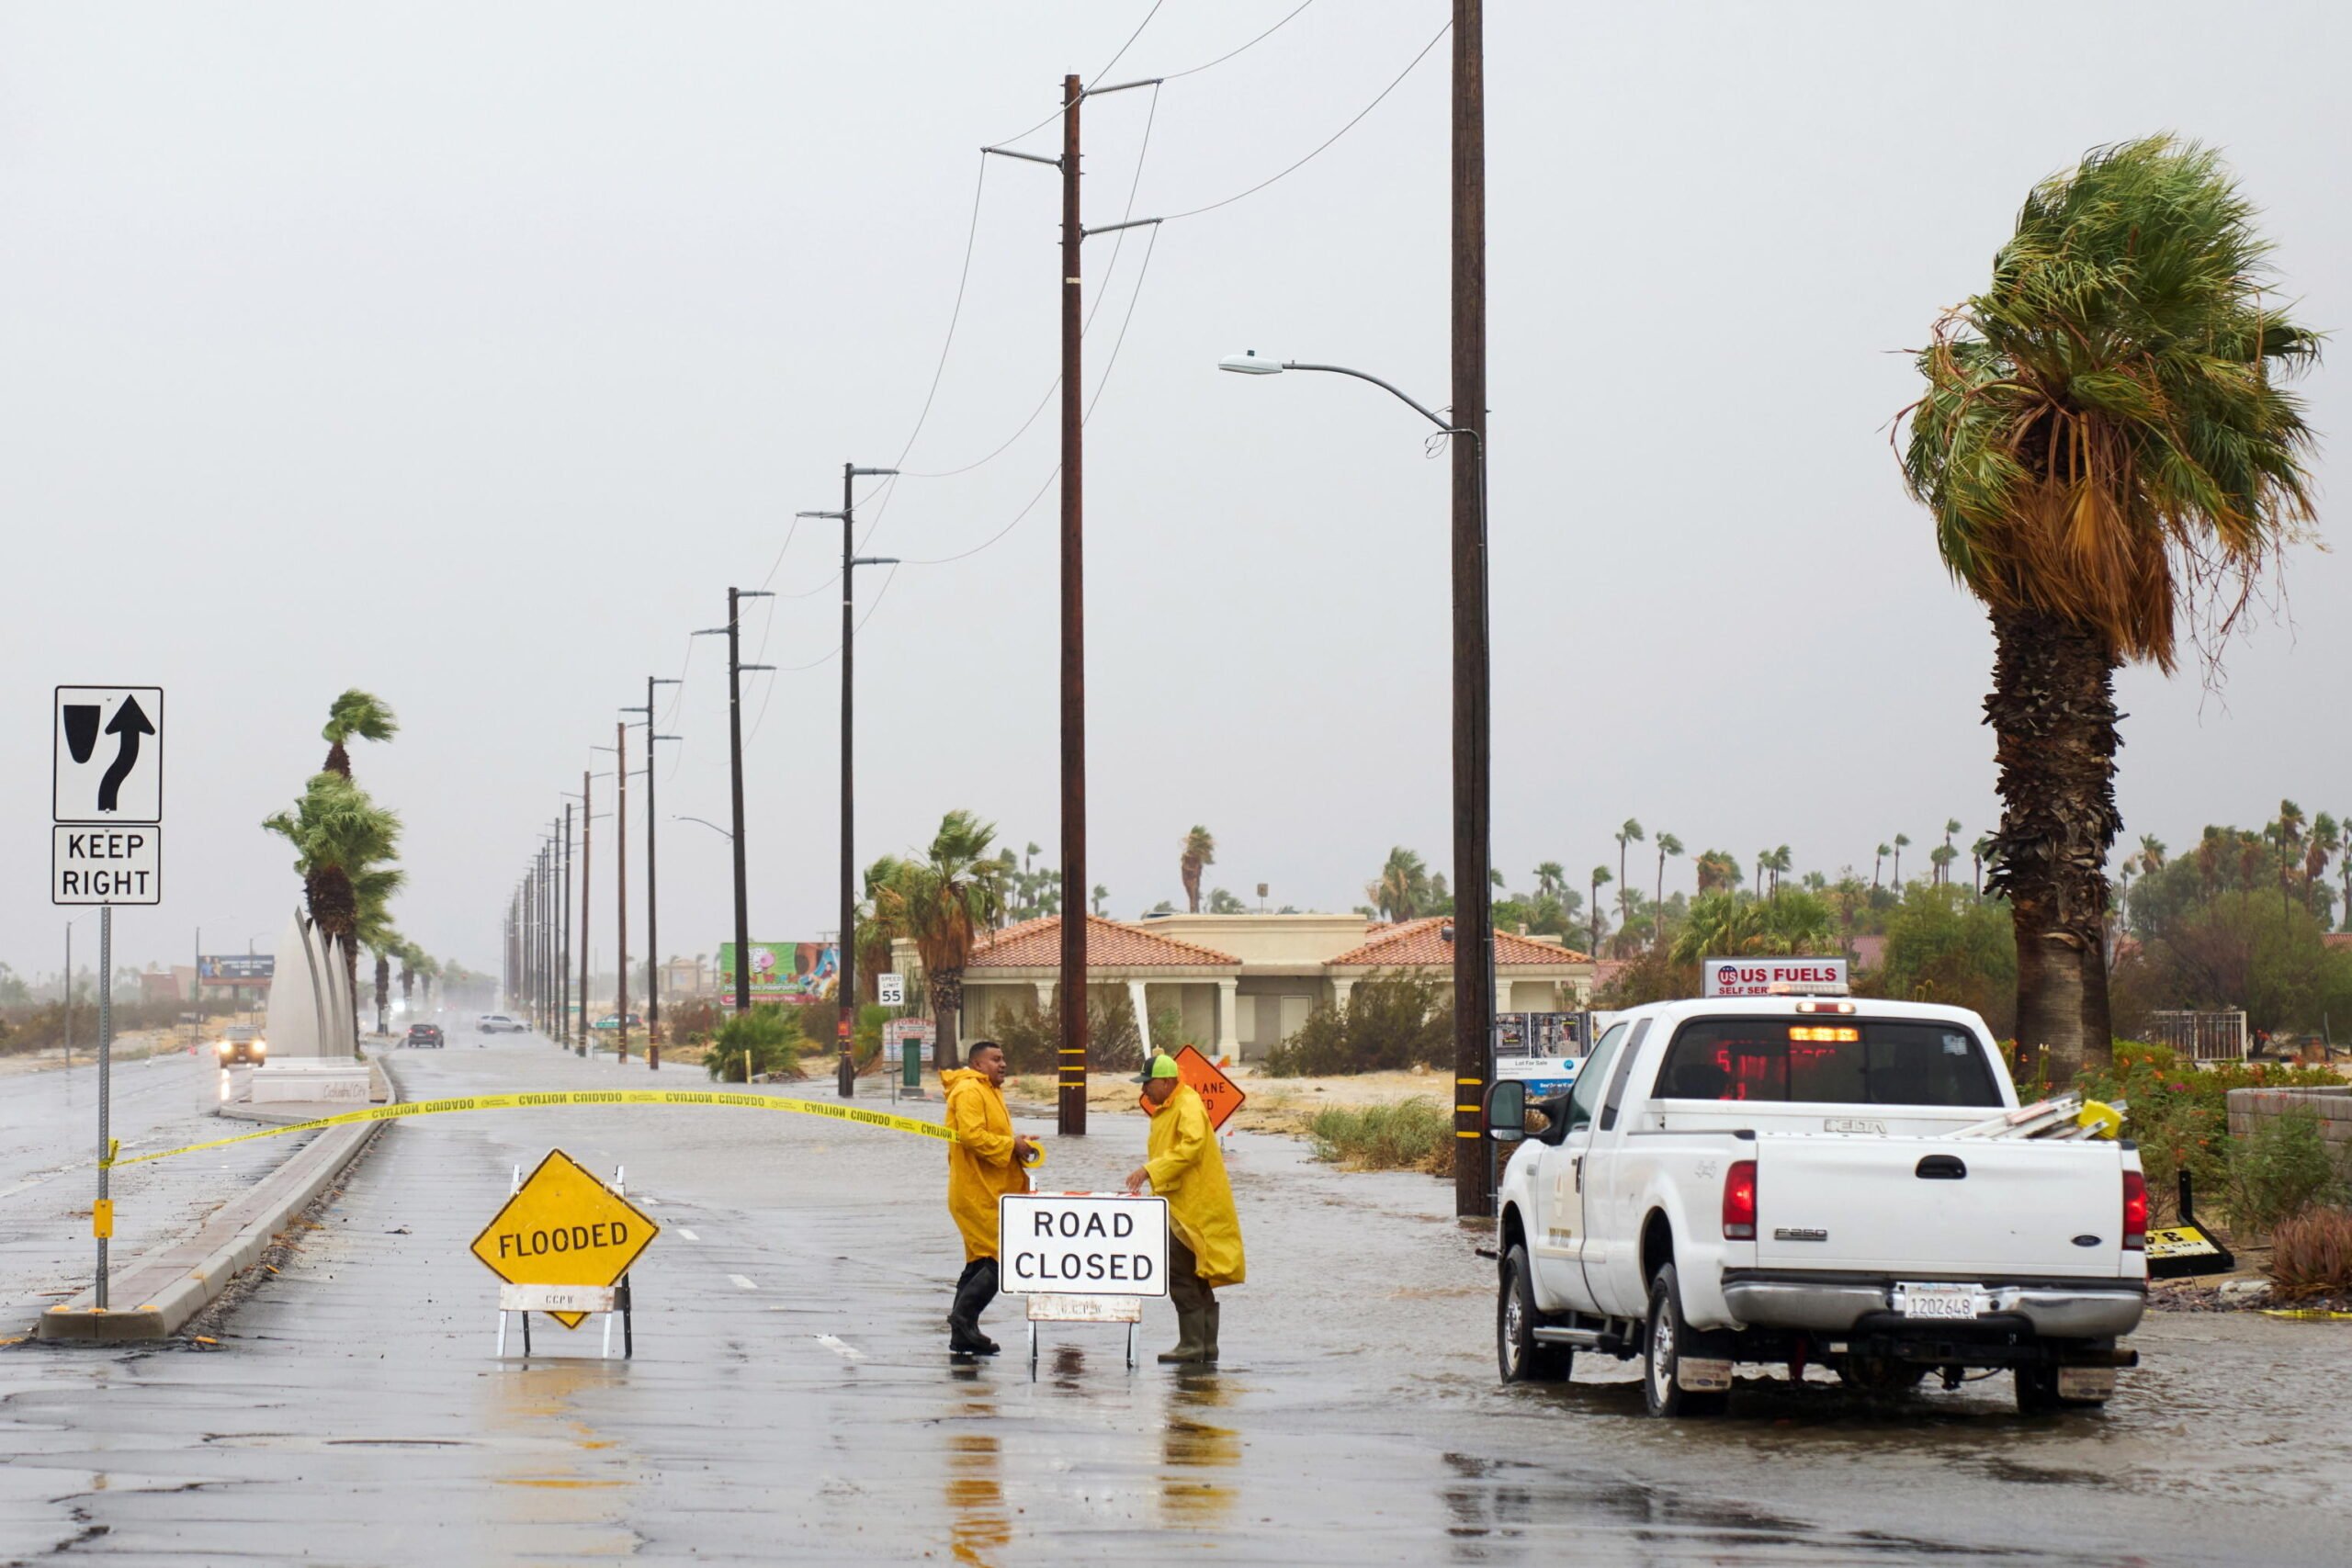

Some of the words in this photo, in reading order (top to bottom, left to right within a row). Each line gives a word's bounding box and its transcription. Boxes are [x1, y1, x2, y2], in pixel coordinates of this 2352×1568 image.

[69, 834, 144, 859] KEEP
[62, 870, 150, 895] RIGHT
[1720, 971, 1736, 983] US
[1740, 968, 1767, 982] US
[1773, 967, 1837, 982] FUELS
[882, 990, 901, 1002] 55
[1719, 986, 1745, 995] SELF
[1747, 986, 1770, 995] SER
[1824, 1118, 1887, 1134] DELTA
[1035, 1211, 1133, 1237] ROAD
[499, 1222, 628, 1258] FLOODED
[1015, 1252, 1153, 1280] CLOSED
[1911, 1298, 1971, 1314] 1202648
